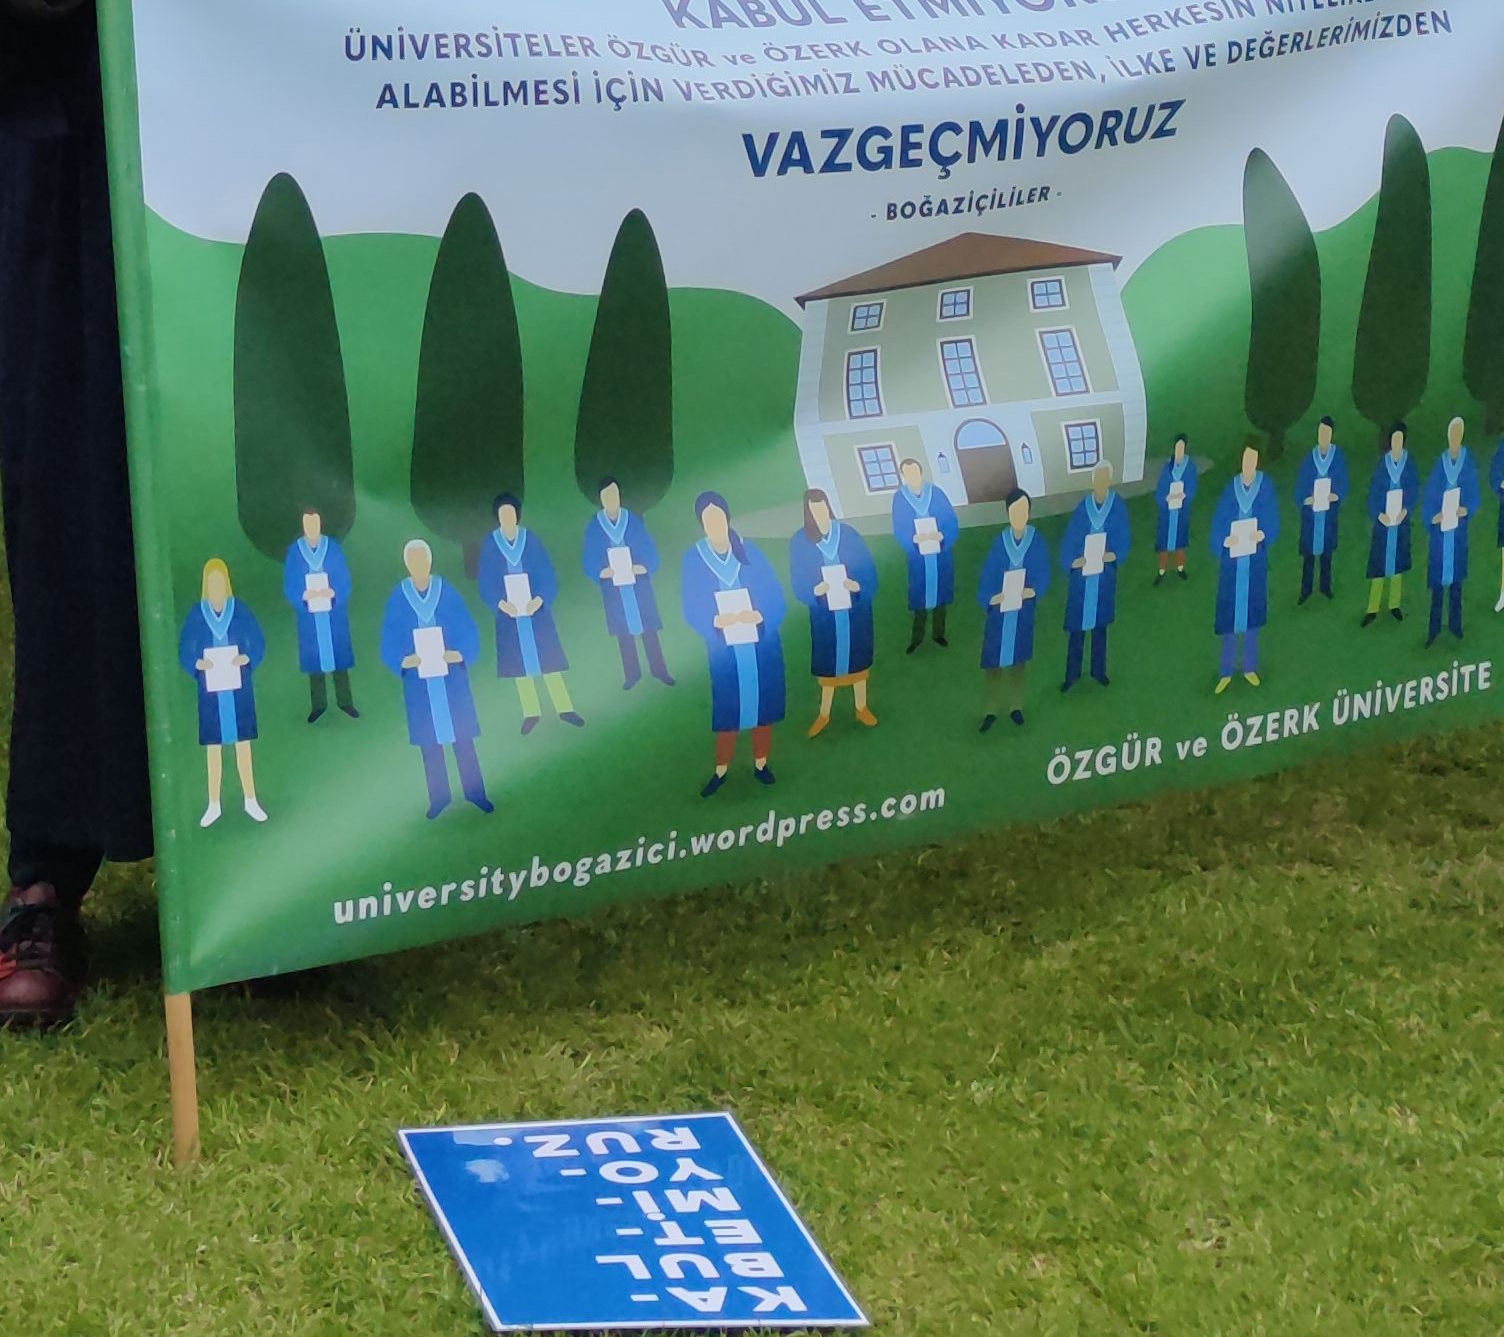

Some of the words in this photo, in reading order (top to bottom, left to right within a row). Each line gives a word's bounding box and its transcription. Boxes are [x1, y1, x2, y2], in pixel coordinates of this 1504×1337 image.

[343, 25, 602, 62] ÜNİVERSİTELER
[606, 33, 716, 69] ÖZGÜR
[723, 51, 757, 67] ve
[762, 38, 873, 65] ÖZERK
[876, 33, 988, 57] OLANA
[995, 26, 1101, 50] KADAR
[374, 69, 581, 111] ALABİLMESİ
[592, 69, 665, 112] İÇİN
[672, 66, 861, 104] VERDİĞİMİZ
[866, 55, 1107, 94] MÜCADELEDEN,
[1110, 46, 1177, 80] İLKE
[1185, 41, 1217, 71] VE
[1226, 8, 1454, 66] DEĞERLERİMİZDEN
[741, 98, 1188, 181] VAZGEÇMİYORUZ
[885, 184, 1052, 222] BOĞAZİÇİLİLER
[1045, 731, 1163, 786] ÖZGÜR
[1175, 735, 1208, 762] ve
[1220, 700, 1321, 752] ÖZERK
[1331, 659, 1493, 727] ÜNİVERSİTE
[332, 784, 947, 925] universitybogazici.wordpress.com
[492, 1125, 702, 1159] RUZ.
[559, 1157, 724, 1185] YO-
[594, 1186, 743, 1222] Mİ-
[614, 1218, 764, 1246] ET-
[594, 1251, 786, 1281] BUL
[629, 1284, 809, 1313] KA-
